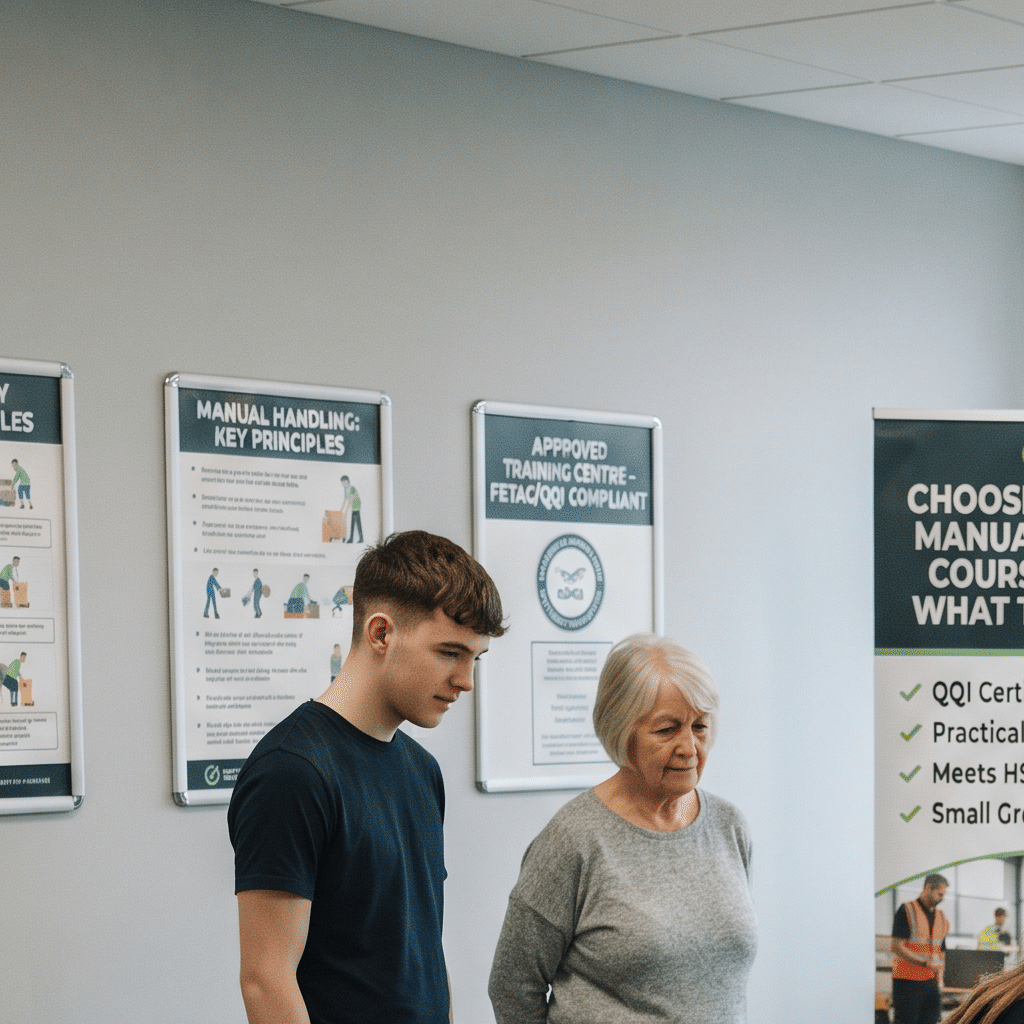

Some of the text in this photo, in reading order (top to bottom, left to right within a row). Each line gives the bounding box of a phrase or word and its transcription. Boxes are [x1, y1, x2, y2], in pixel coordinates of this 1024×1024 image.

[197, 400, 360, 432] MANUAL HANDLING:
[214, 425, 346, 457] KEY PRINCIPLES
[502, 457, 571, 483] TRAINING
[573, 462, 627, 486] CENTRE
[568, 486, 648, 511] COMPLIANT
[911, 595, 1010, 626] WHAT
[932, 680, 971, 708] QQI
[933, 762, 997, 784] Meets
[932, 801, 990, 824] Small
